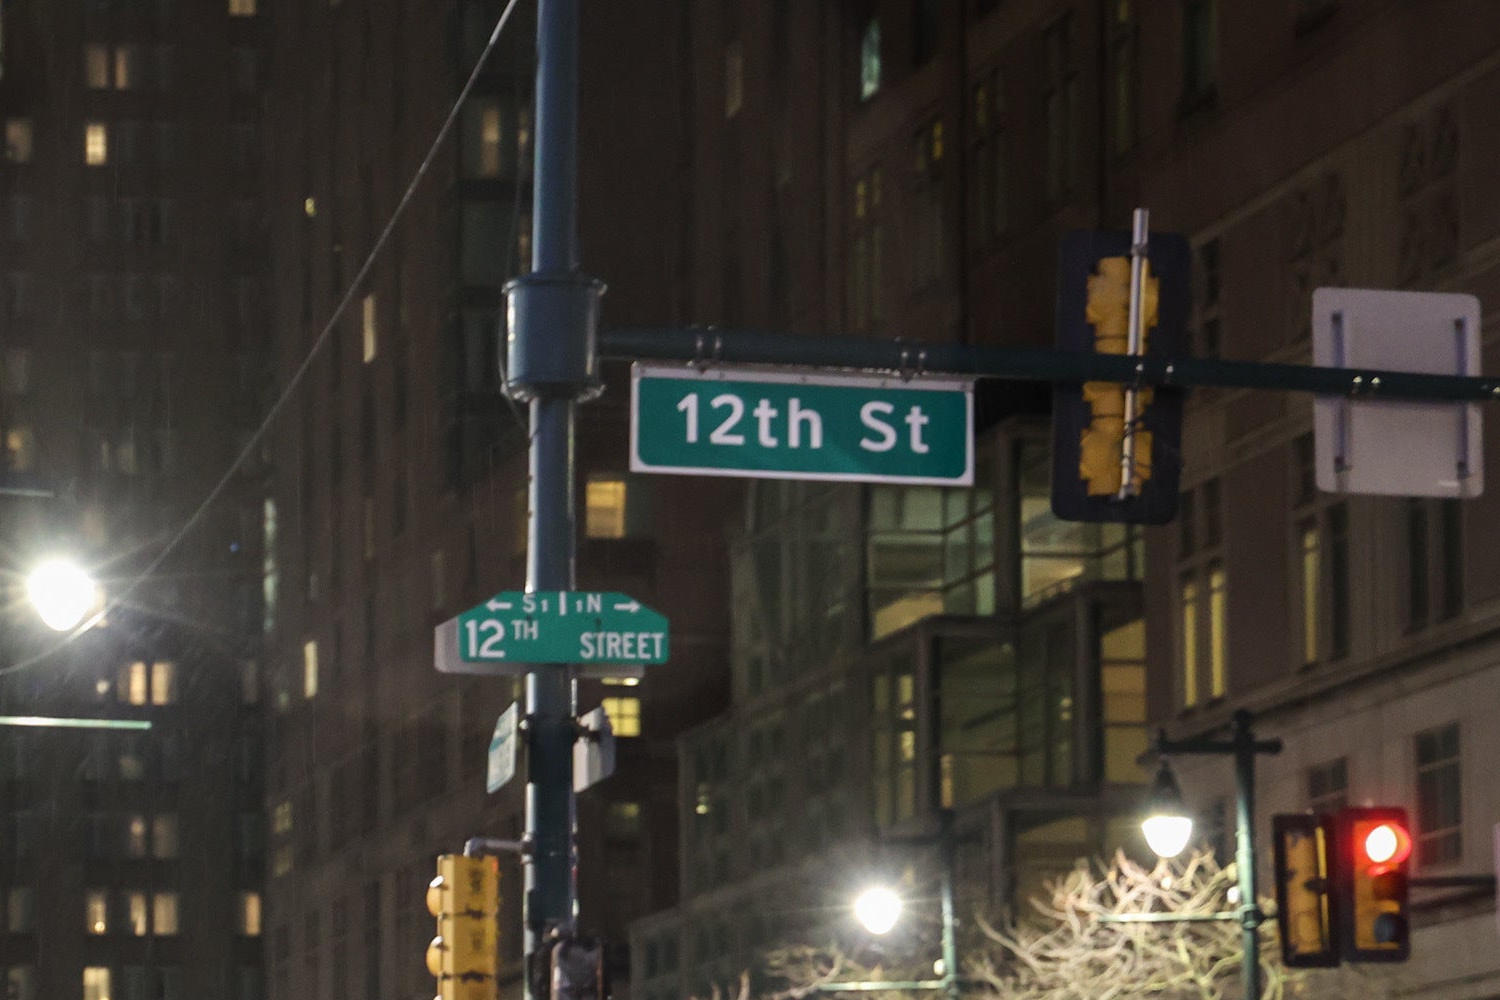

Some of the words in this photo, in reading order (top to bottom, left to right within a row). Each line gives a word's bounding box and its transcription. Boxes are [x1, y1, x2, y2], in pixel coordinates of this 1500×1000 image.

[676, 392, 823, 449] 12th
[858, 400, 930, 453] St
[579, 631, 665, 660] STREET
